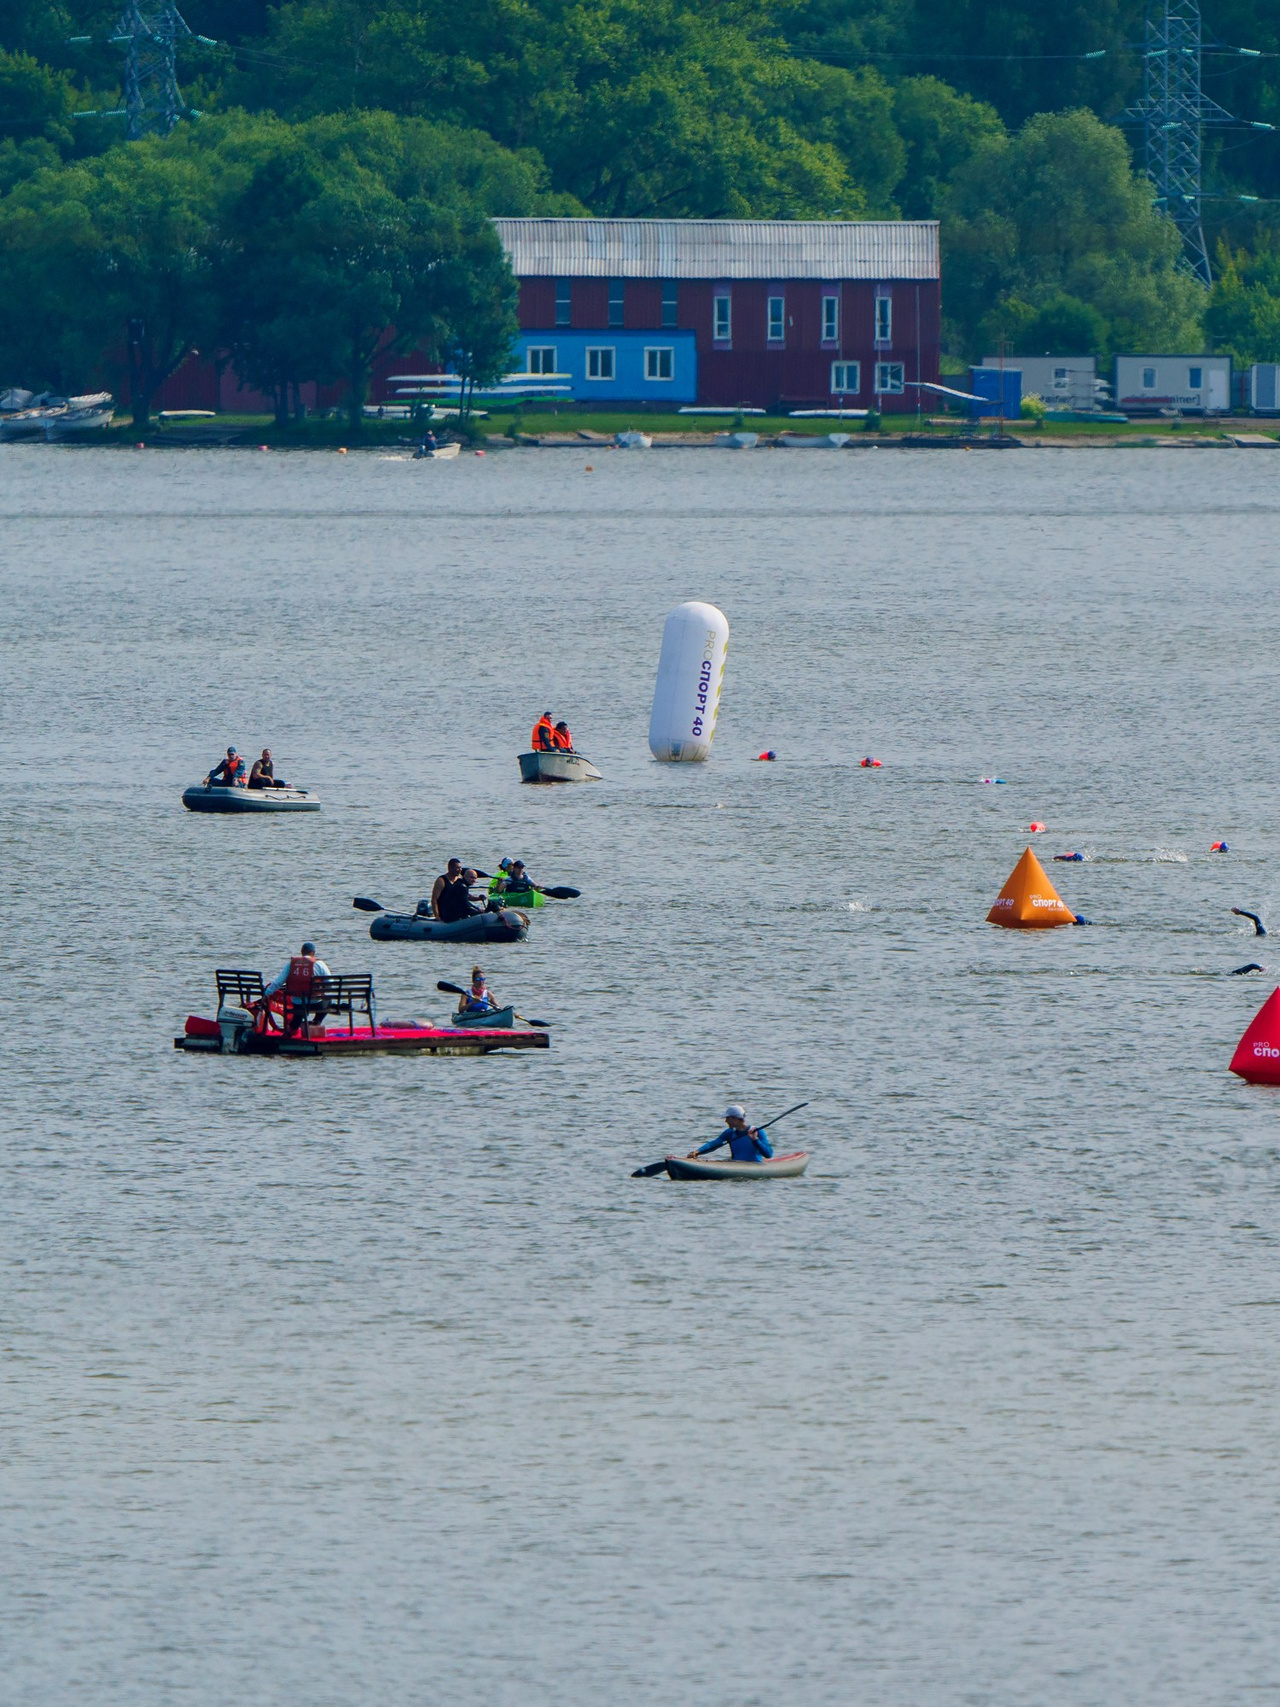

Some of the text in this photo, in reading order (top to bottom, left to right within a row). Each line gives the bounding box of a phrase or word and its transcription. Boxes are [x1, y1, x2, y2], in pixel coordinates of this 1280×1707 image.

[692, 660, 712, 737] СПОРТ 40
[1032, 899, 1056, 907] СПОРТ
